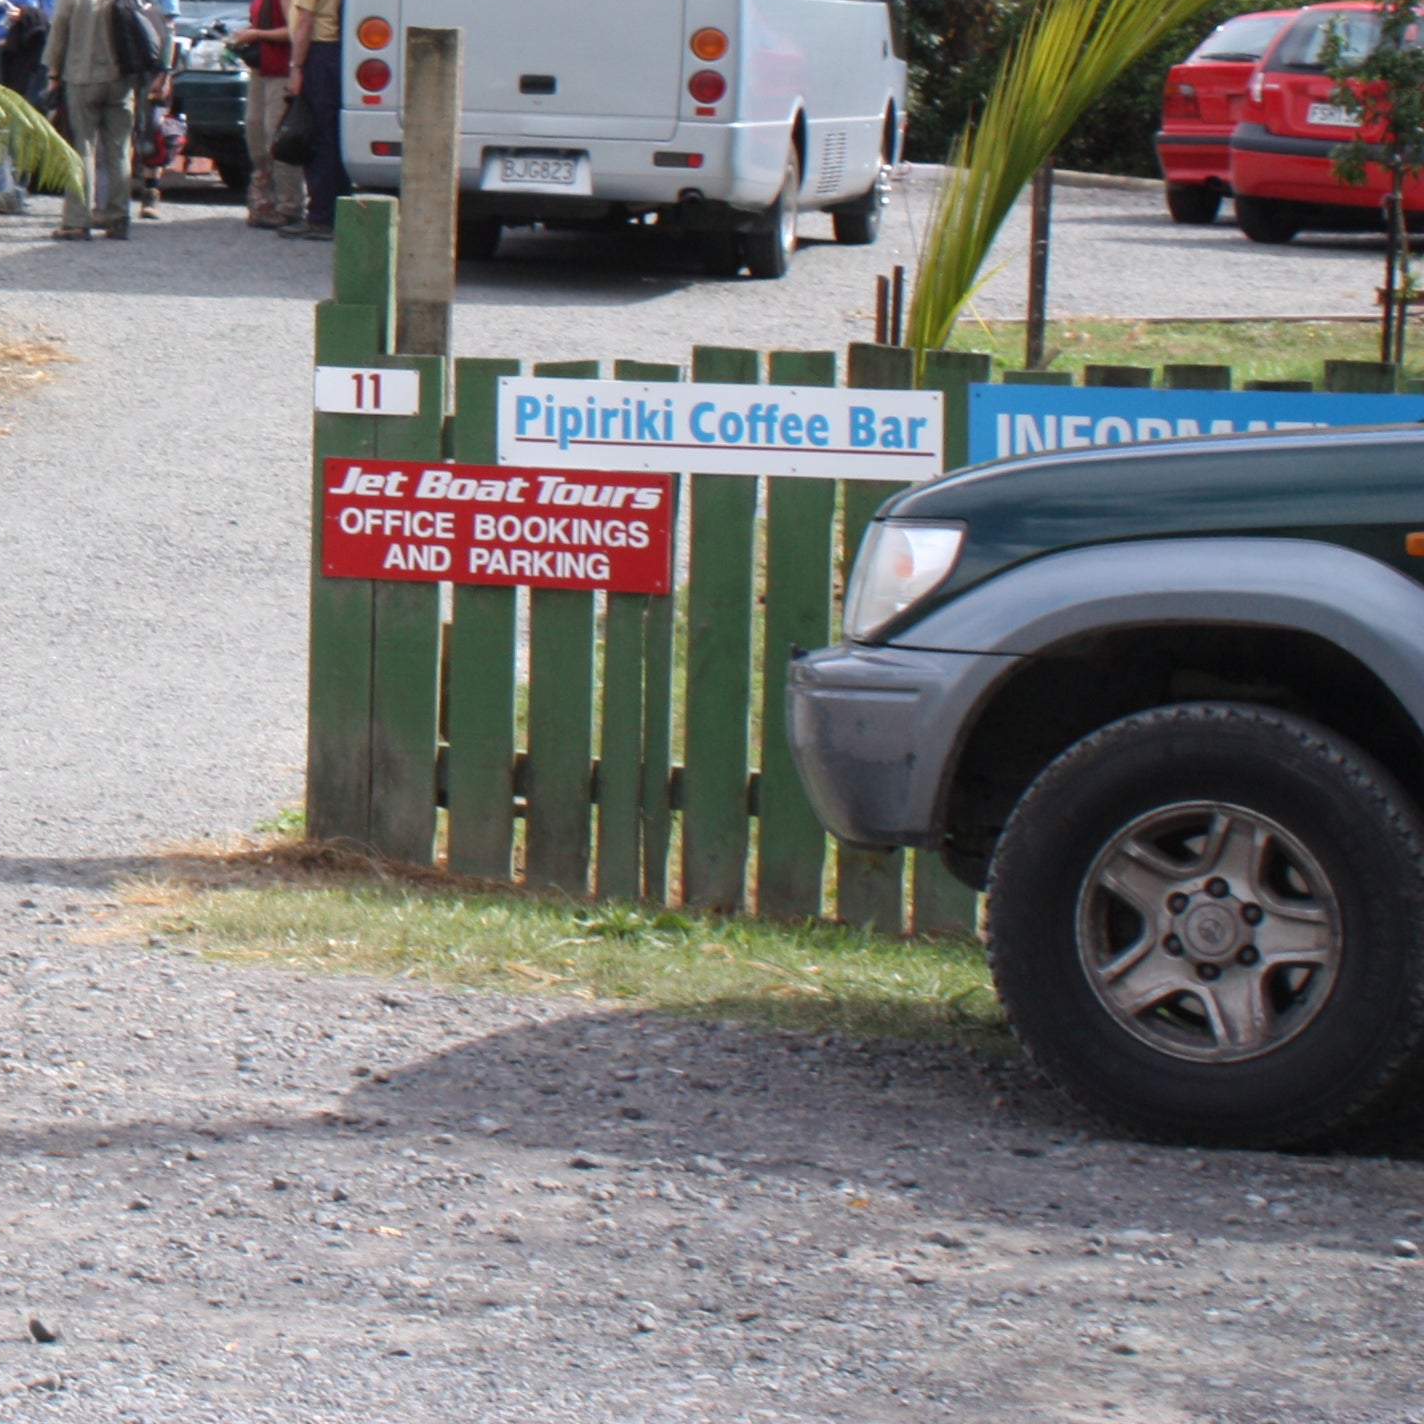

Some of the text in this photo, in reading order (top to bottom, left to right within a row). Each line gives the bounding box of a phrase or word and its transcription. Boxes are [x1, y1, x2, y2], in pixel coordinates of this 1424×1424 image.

[504, 159, 572, 180] BJG823
[352, 373, 381, 409] 11
[515, 395, 928, 450] Pipiriki Coffee Bar
[328, 466, 664, 510] Jet Boat Tours
[339, 507, 650, 549] OFFICE BOOKINGS
[383, 543, 610, 581] AND PARKING
